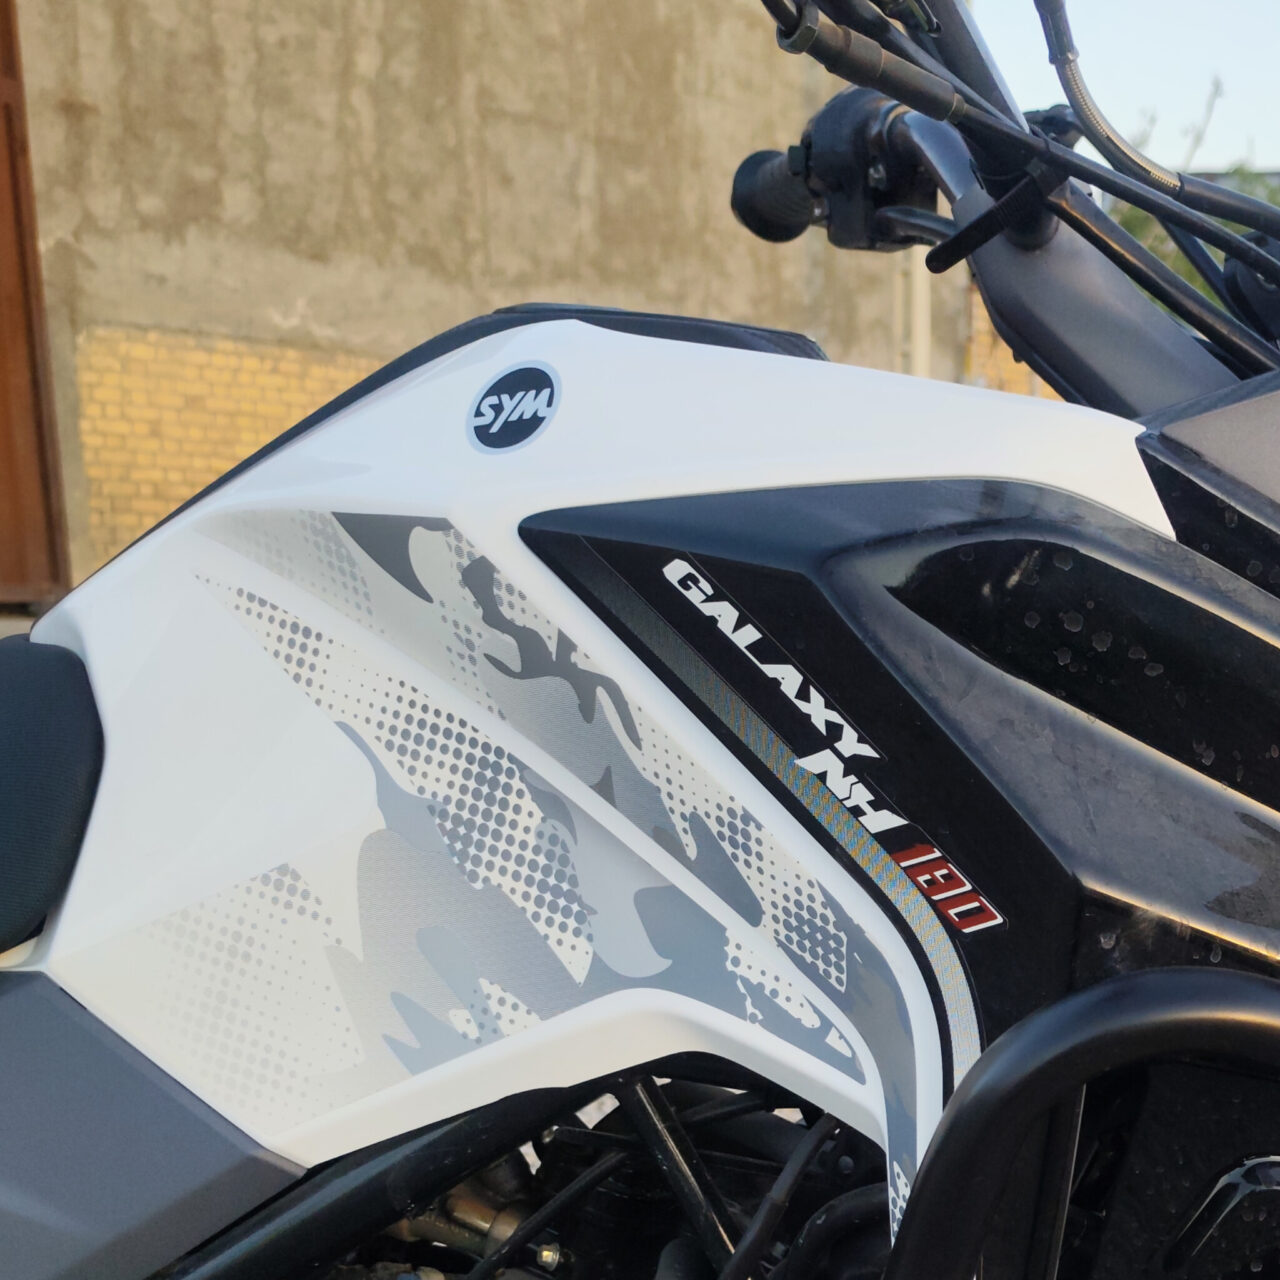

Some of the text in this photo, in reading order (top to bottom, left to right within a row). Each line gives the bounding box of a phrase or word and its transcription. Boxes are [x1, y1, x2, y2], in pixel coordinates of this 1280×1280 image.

[474, 388, 552, 433] SYM
[662, 558, 1004, 933] GALAXY NH 180
